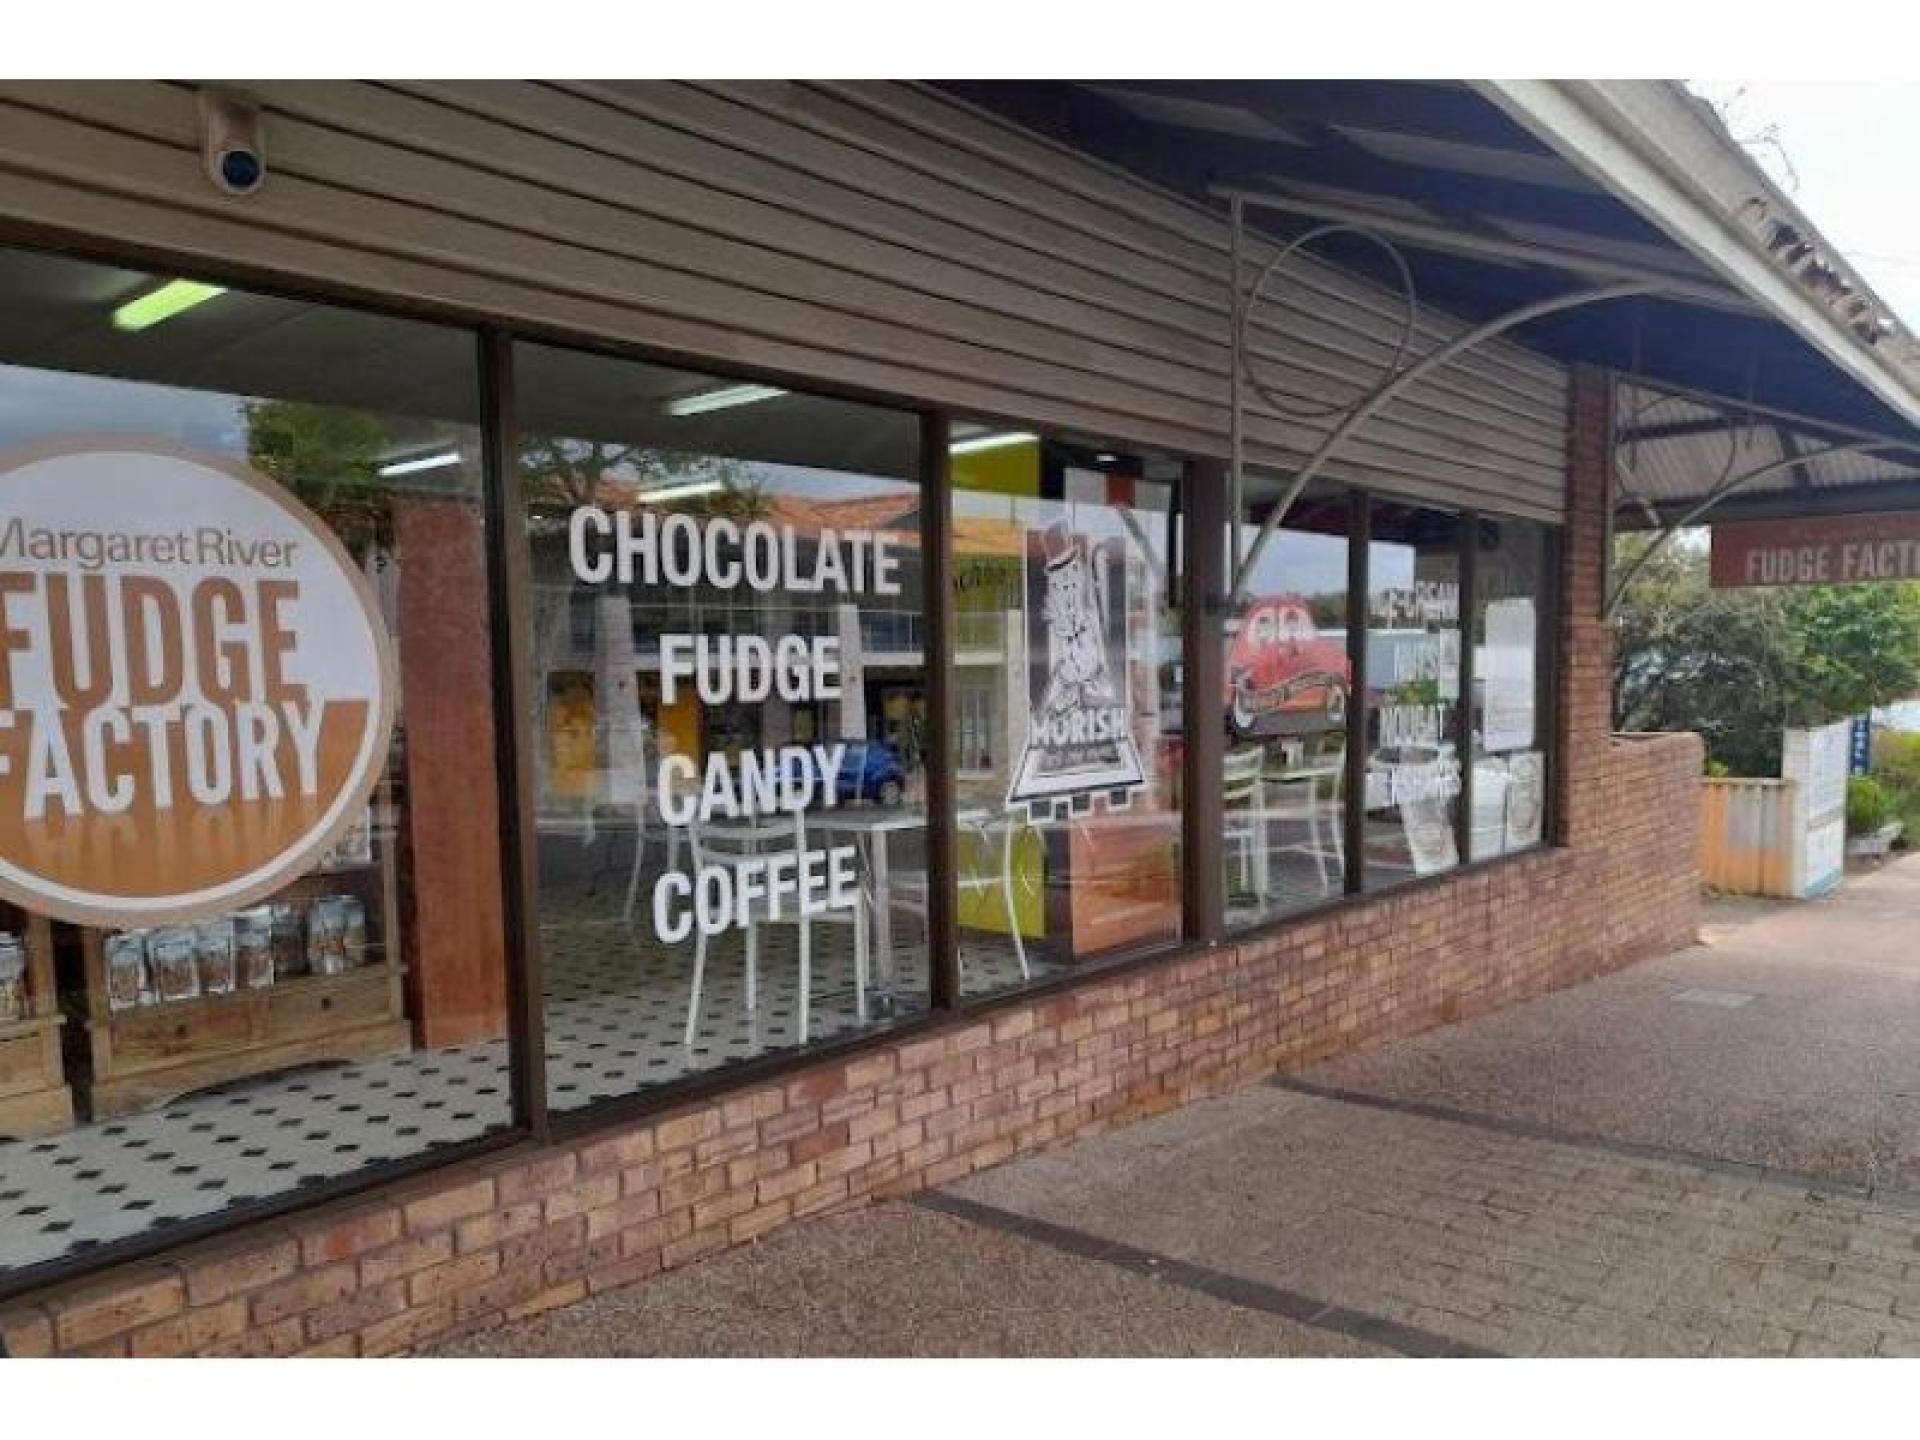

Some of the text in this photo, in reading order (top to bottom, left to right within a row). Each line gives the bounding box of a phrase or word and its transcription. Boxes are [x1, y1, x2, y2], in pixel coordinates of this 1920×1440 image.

[197, 527, 297, 567] River
[568, 506, 902, 596] CHOCOLATE
[1746, 543, 1831, 583] FUDGE
[658, 633, 841, 705] FUDGE
[658, 743, 847, 827] CANDY
[652, 846, 858, 944] COFFEE
